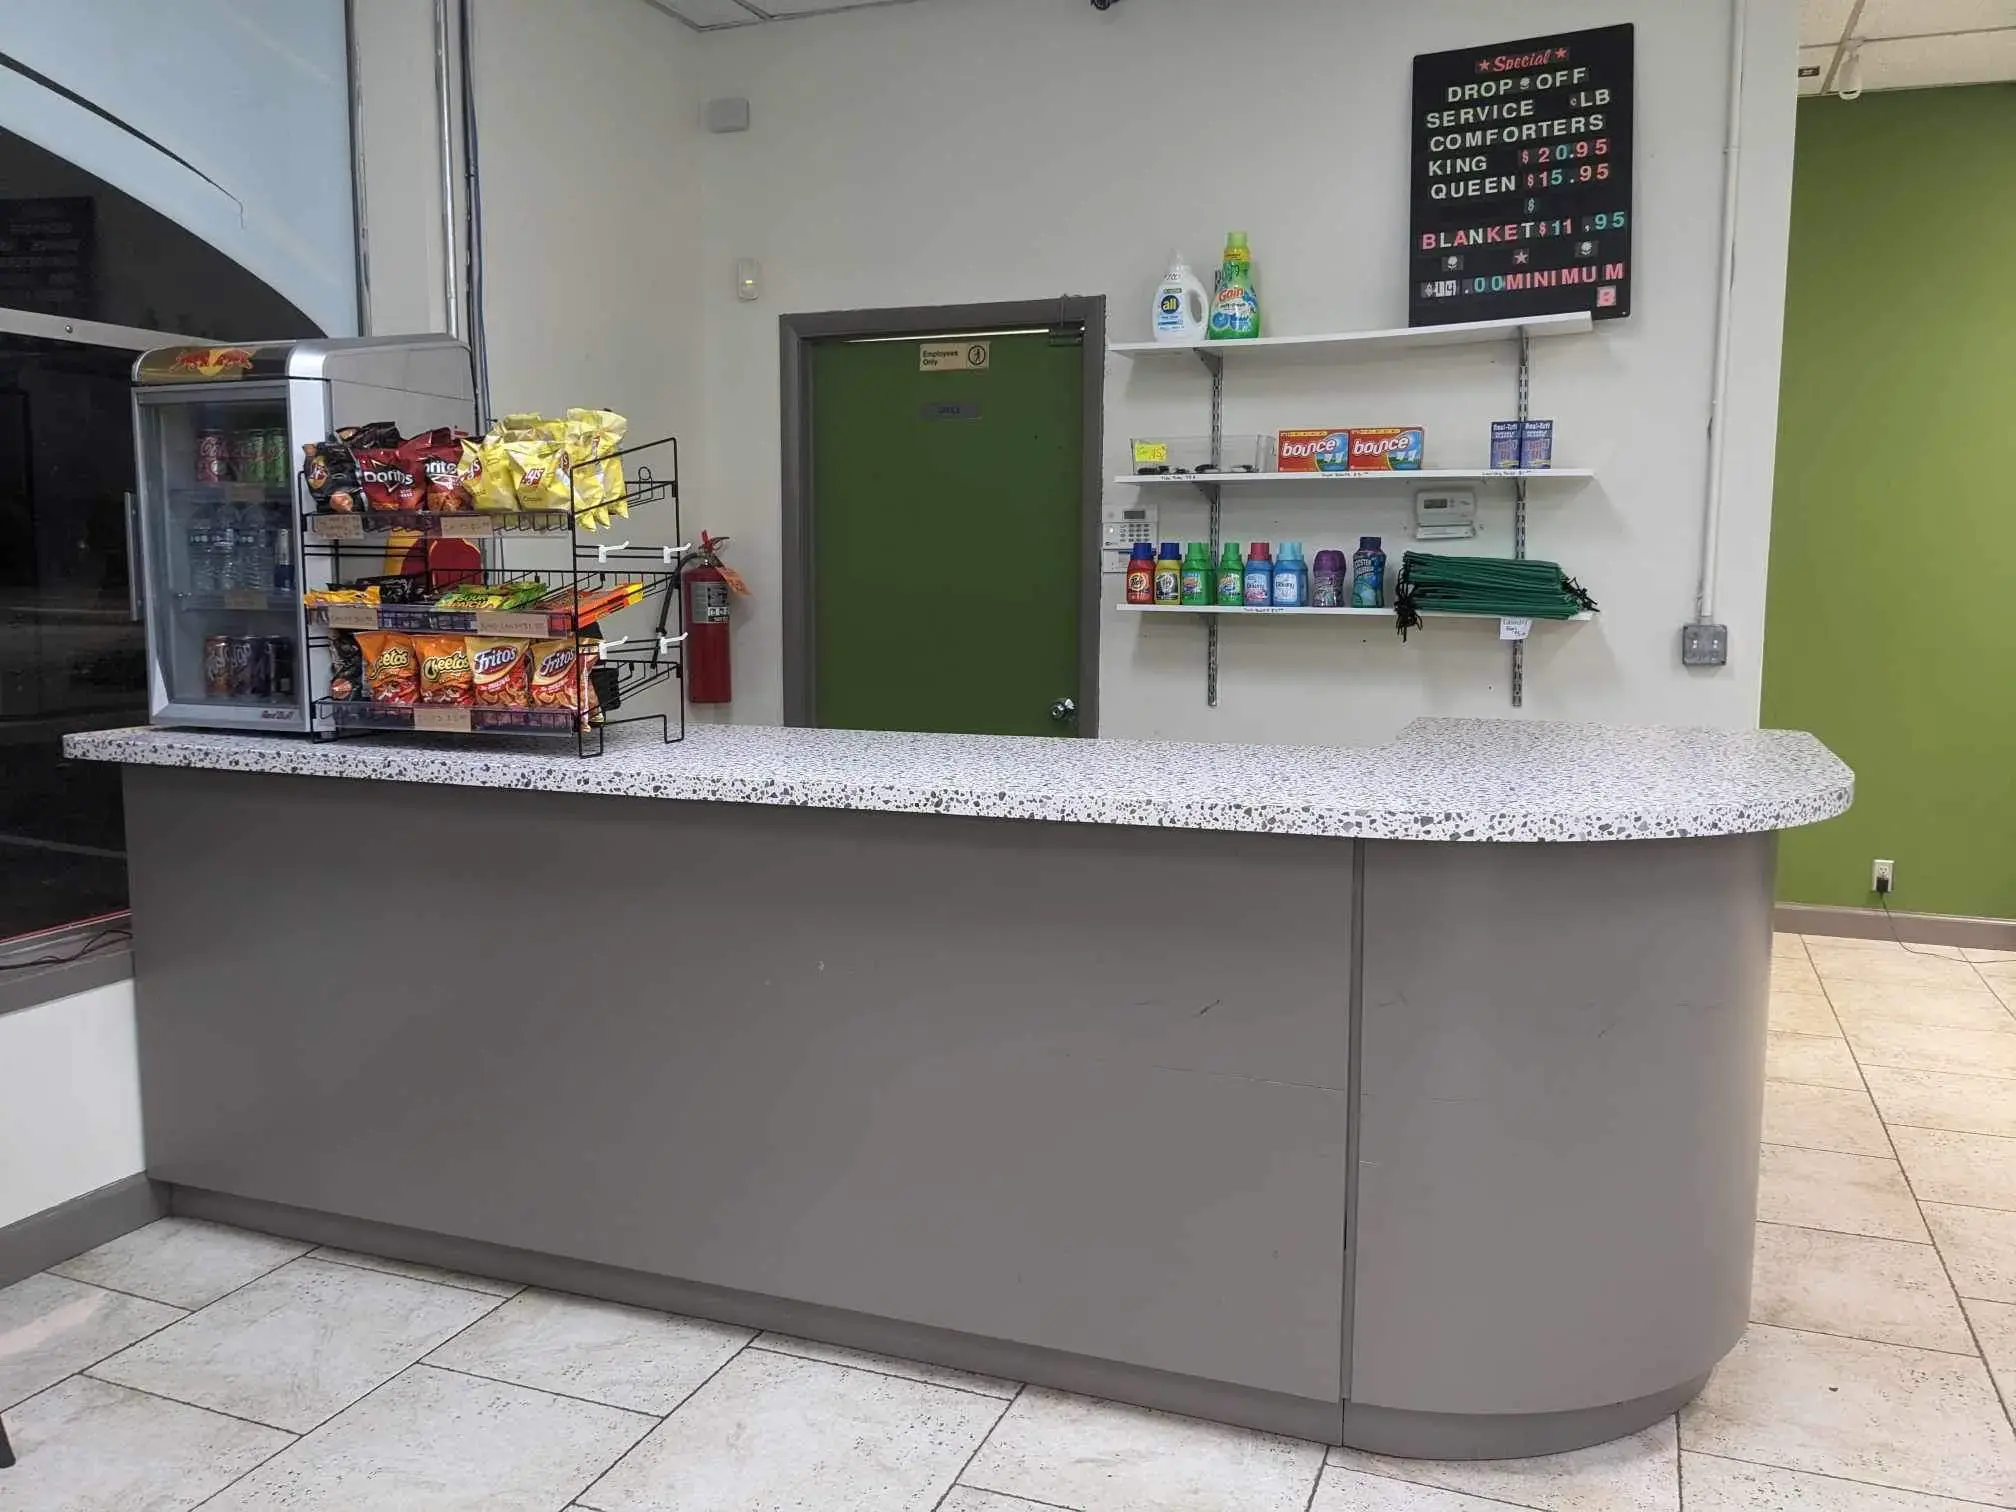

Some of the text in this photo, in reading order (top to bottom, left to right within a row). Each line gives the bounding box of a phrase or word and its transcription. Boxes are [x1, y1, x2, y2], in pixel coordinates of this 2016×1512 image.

[1493, 49, 1552, 72] Special
[1447, 67, 1587, 103] DROP OFF
[1426, 100, 1534, 128] SERVICE
[1430, 114, 1604, 152] COMFORTERS
[1428, 139, 1609, 177] KING $20.95
[1431, 162, 1609, 200] QUEEN $15.95
[1422, 222, 1535, 250] BLANKET
[1505, 262, 1624, 290] MINIMUM
[1162, 299, 1177, 311] all
[1219, 288, 1244, 302] Gain
[922, 350, 959, 358] Employees
[922, 358, 938, 366] Only
[1282, 438, 1337, 457] bounce
[1353, 436, 1409, 456] bounce
[474, 647, 517, 674] Fritos
[540, 648, 576, 676] Fritos
